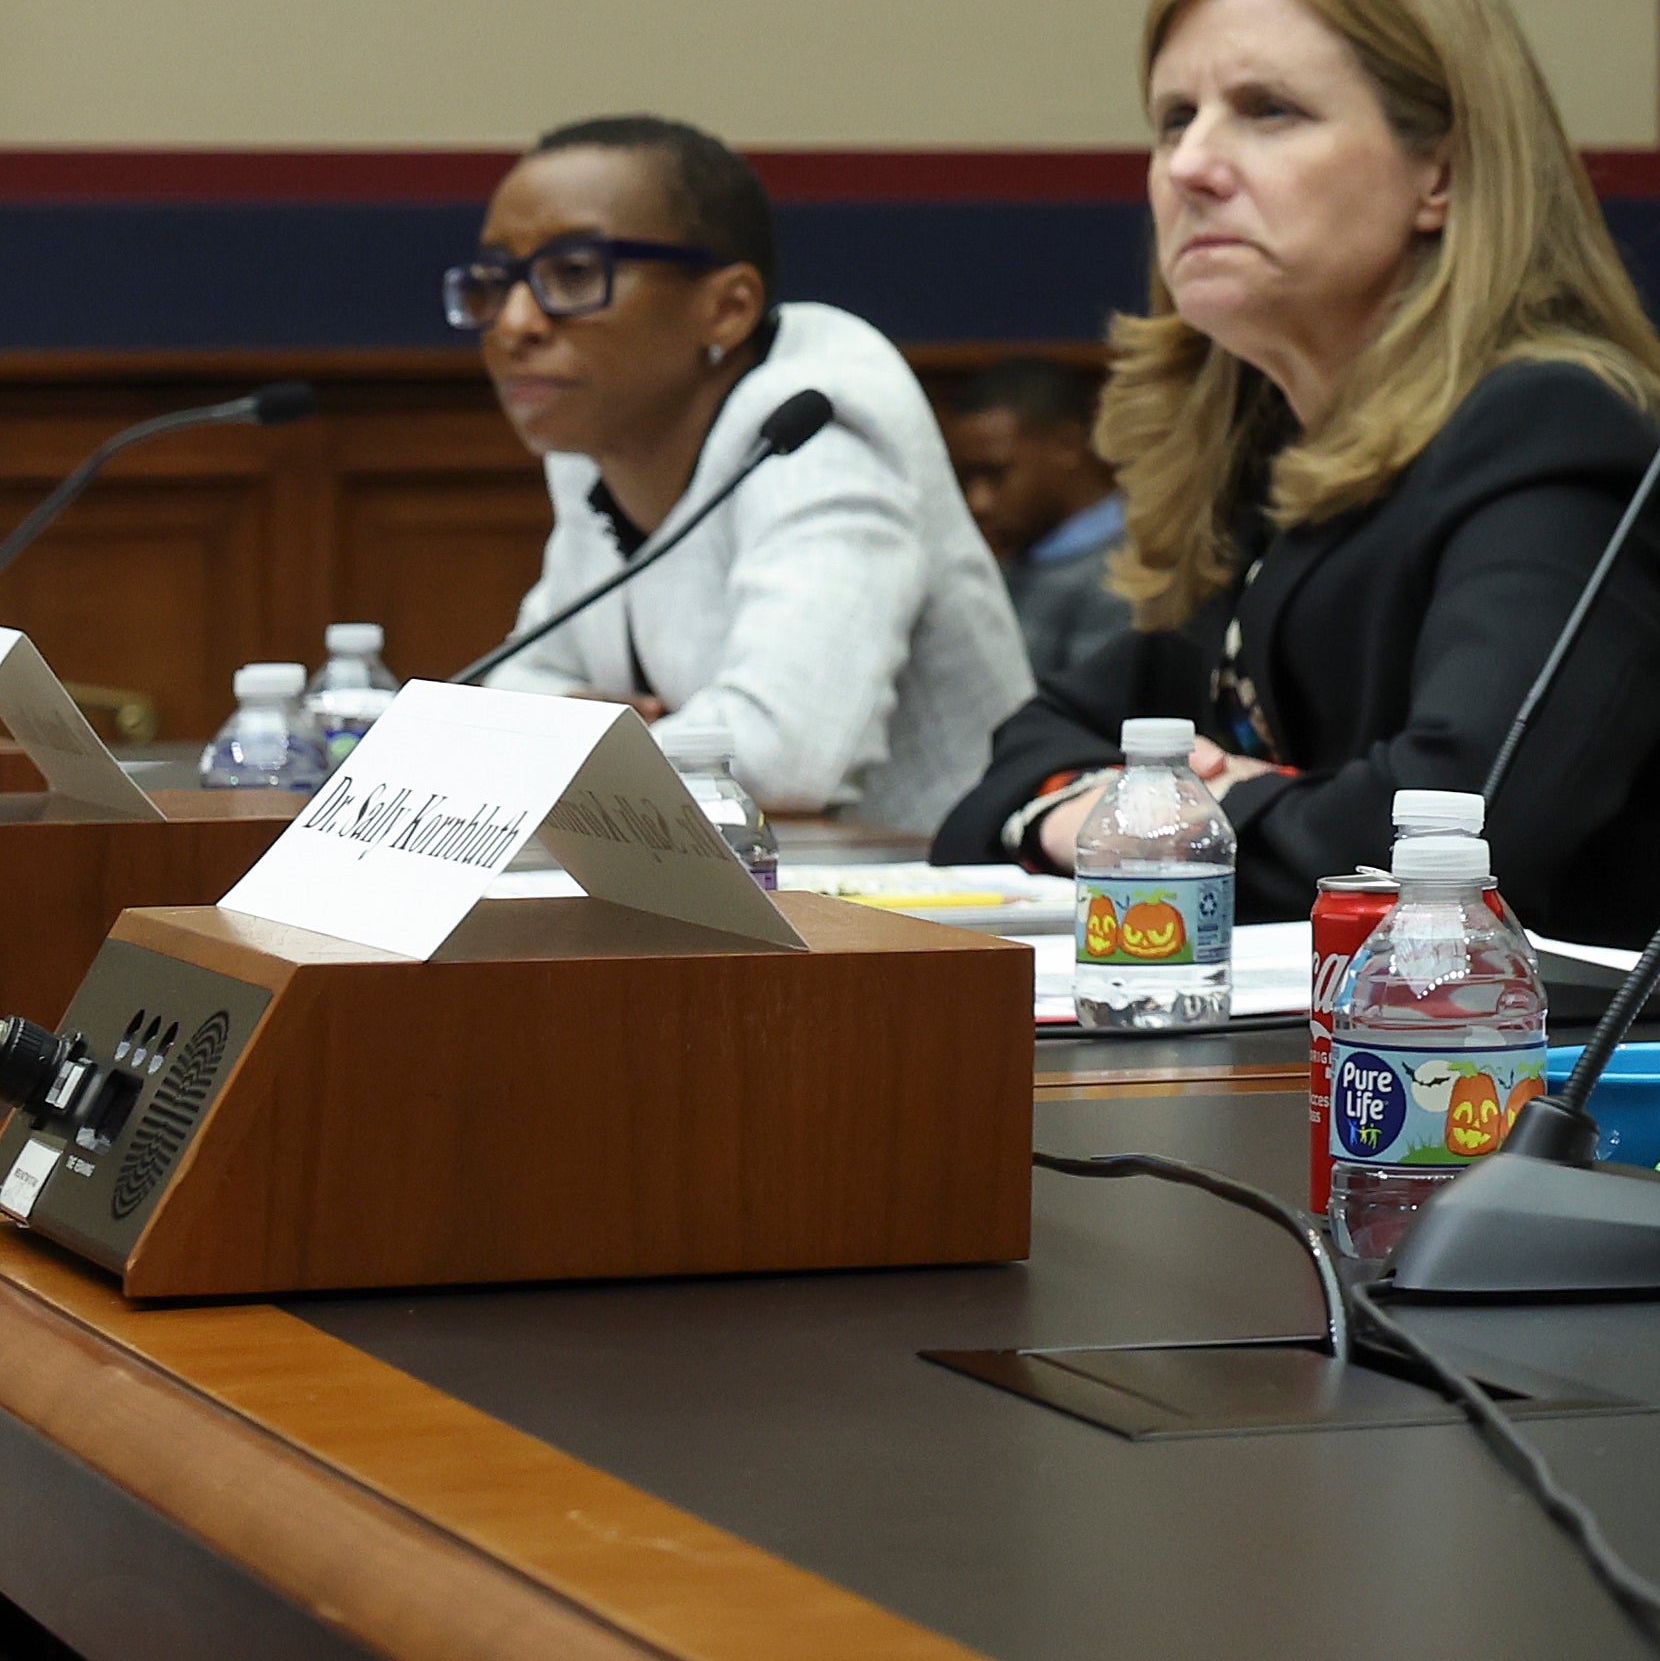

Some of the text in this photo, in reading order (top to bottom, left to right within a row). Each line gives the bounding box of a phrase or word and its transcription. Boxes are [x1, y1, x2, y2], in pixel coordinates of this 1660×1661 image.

[302, 776, 355, 833] Dr.
[338, 783, 412, 860] Sally
[388, 794, 528, 868] Kornbluth
[1343, 1061, 1393, 1092] Pure
[1346, 1090, 1384, 1125] Life
